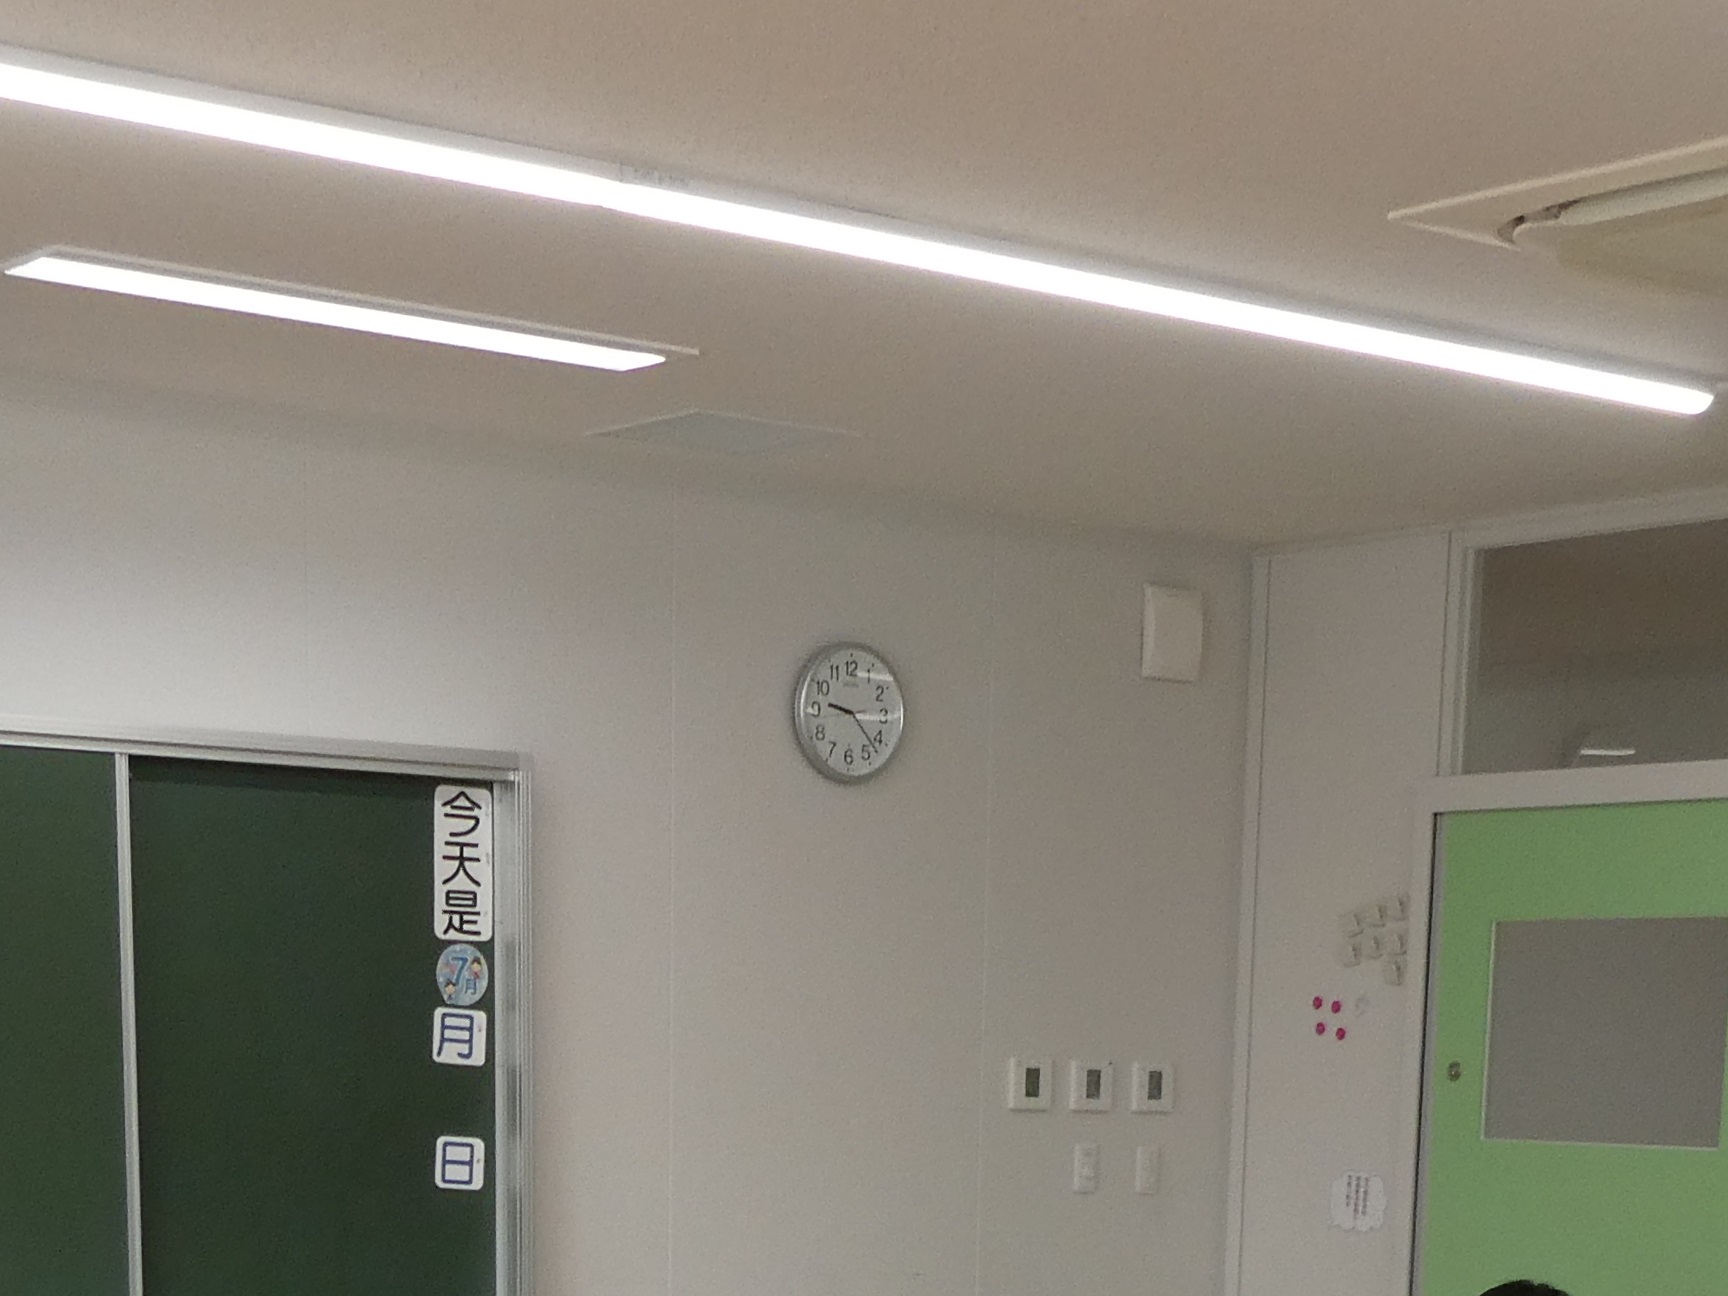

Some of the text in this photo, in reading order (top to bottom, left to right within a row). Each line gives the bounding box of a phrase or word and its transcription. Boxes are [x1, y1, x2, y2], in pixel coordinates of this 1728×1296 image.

[830, 665, 839, 681] 11
[845, 661, 858, 677] 12
[816, 681, 830, 695] 10
[876, 686, 884, 702] 2
[811, 702, 821, 717] 9
[879, 709, 888, 724] 3
[815, 725, 825, 741] 8
[874, 730, 883, 746] 4
[829, 742, 836, 758] 7
[844, 749, 854, 765] 6
[861, 744, 870, 760] 5
[441, 791, 482, 936] 今天是
[436, 1012, 475, 1059] 月
[441, 1141, 474, 1185] 日
